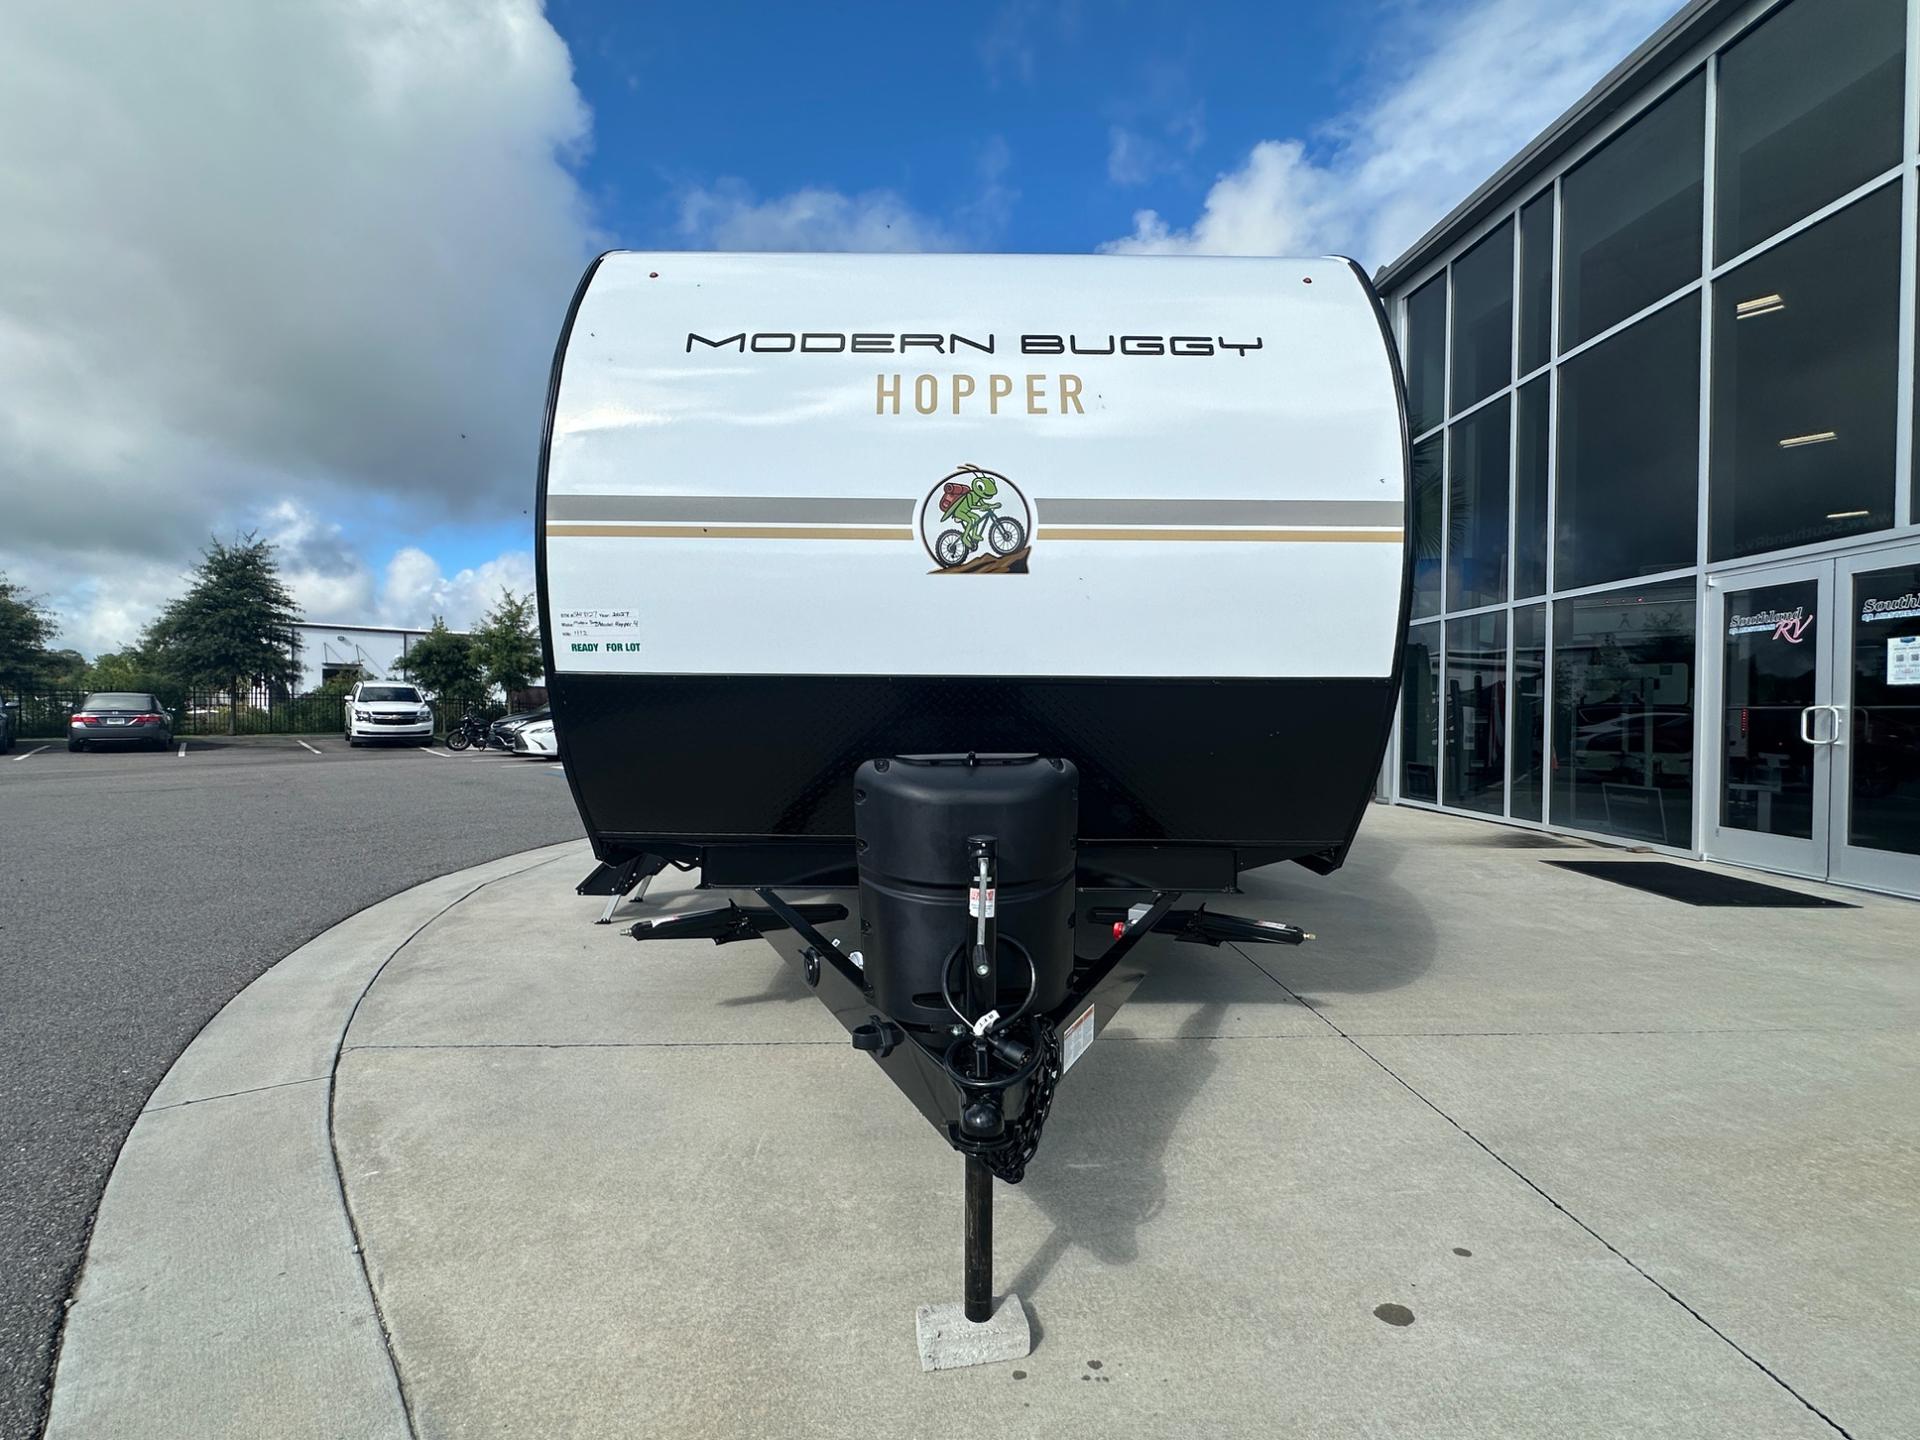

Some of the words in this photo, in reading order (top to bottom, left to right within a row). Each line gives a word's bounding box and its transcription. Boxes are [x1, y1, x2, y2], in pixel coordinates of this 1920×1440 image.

[686, 333, 994, 354] MODERN
[1021, 335, 1263, 357] BUGGY
[876, 374, 1085, 415] HOPPER
[1729, 606, 1803, 627] Southland
[1772, 614, 1813, 643] RV
[571, 643, 598, 652] READY
[606, 643, 623, 652] FOR
[625, 643, 641, 652] LOT
